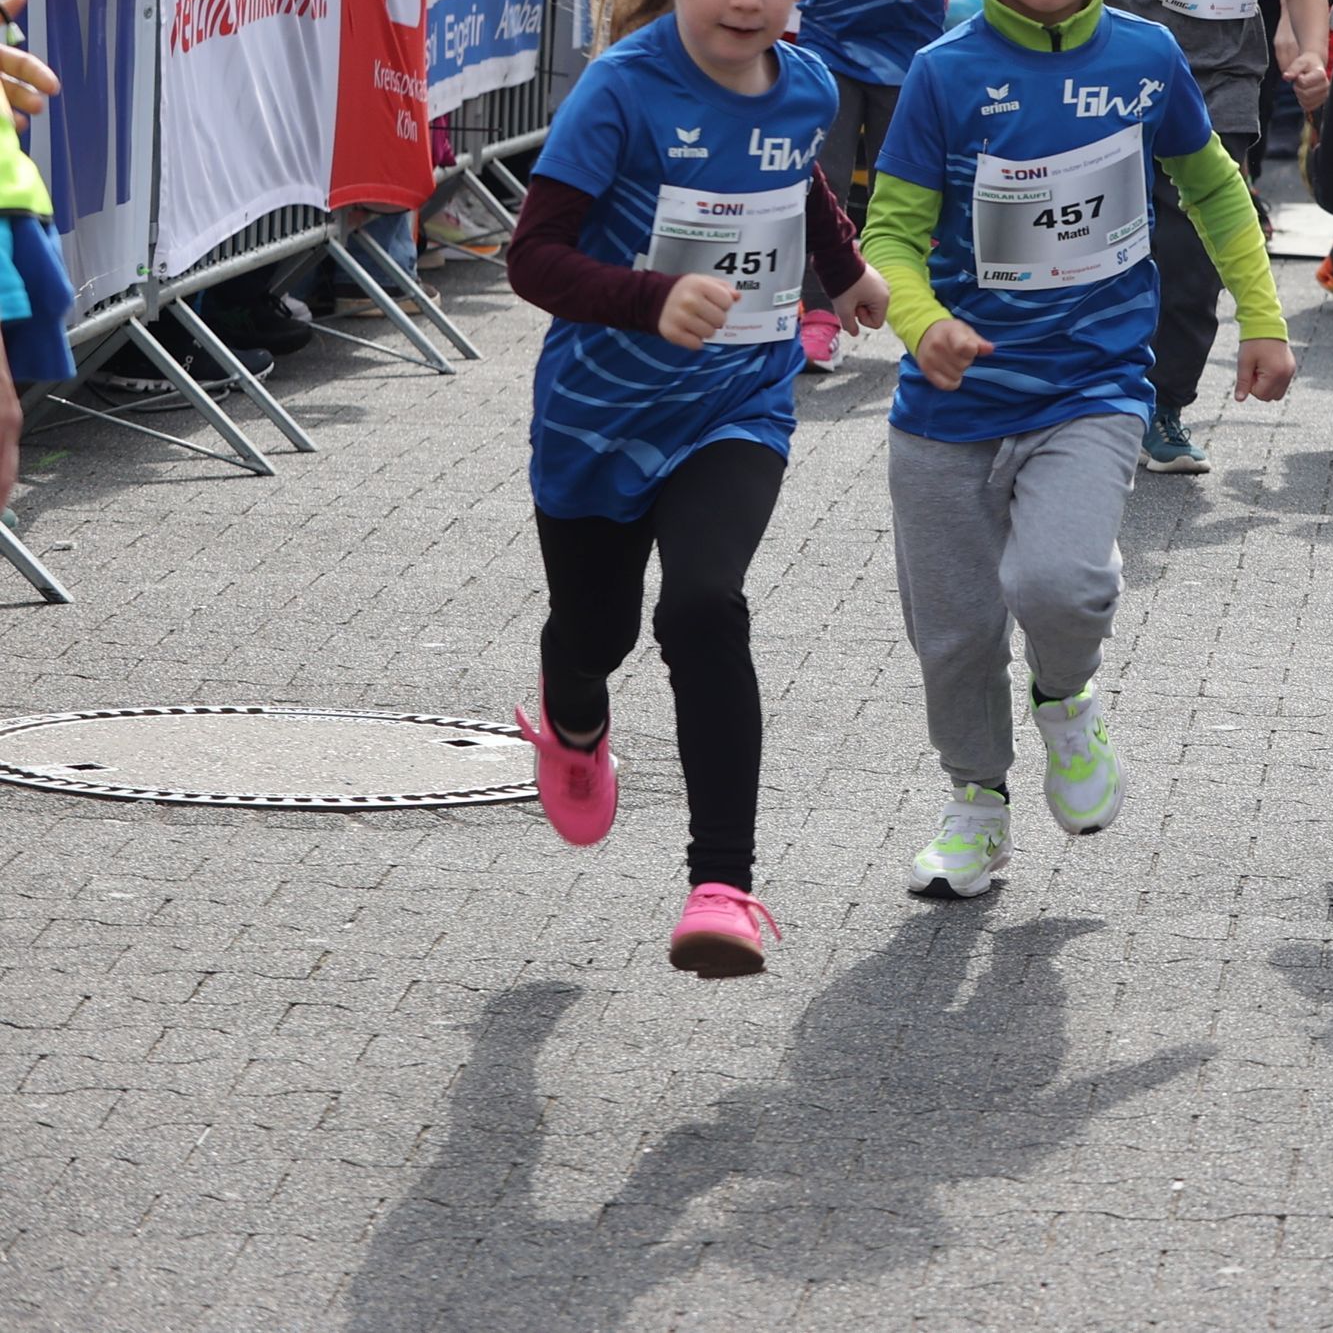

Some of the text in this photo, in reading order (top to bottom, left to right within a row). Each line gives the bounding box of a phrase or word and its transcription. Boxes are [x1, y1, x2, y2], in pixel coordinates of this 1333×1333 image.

[1063, 78, 1139, 117] LGW
[981, 100, 1020, 116] erima
[396, 109, 418, 143] Köln
[668, 145, 709, 159] erima
[1014, 166, 1048, 181] ONI
[977, 190, 1047, 201] LINDLAR LÄUFT
[711, 203, 744, 216] ONI
[1032, 194, 1105, 230] 457
[659, 224, 738, 239] LINDLAR LÄUFT
[1057, 225, 1090, 242] Matti
[713, 248, 778, 275] 451
[1116, 248, 1129, 265] SC
[983, 270, 1019, 282] LANG
[735, 280, 761, 291] Mila
